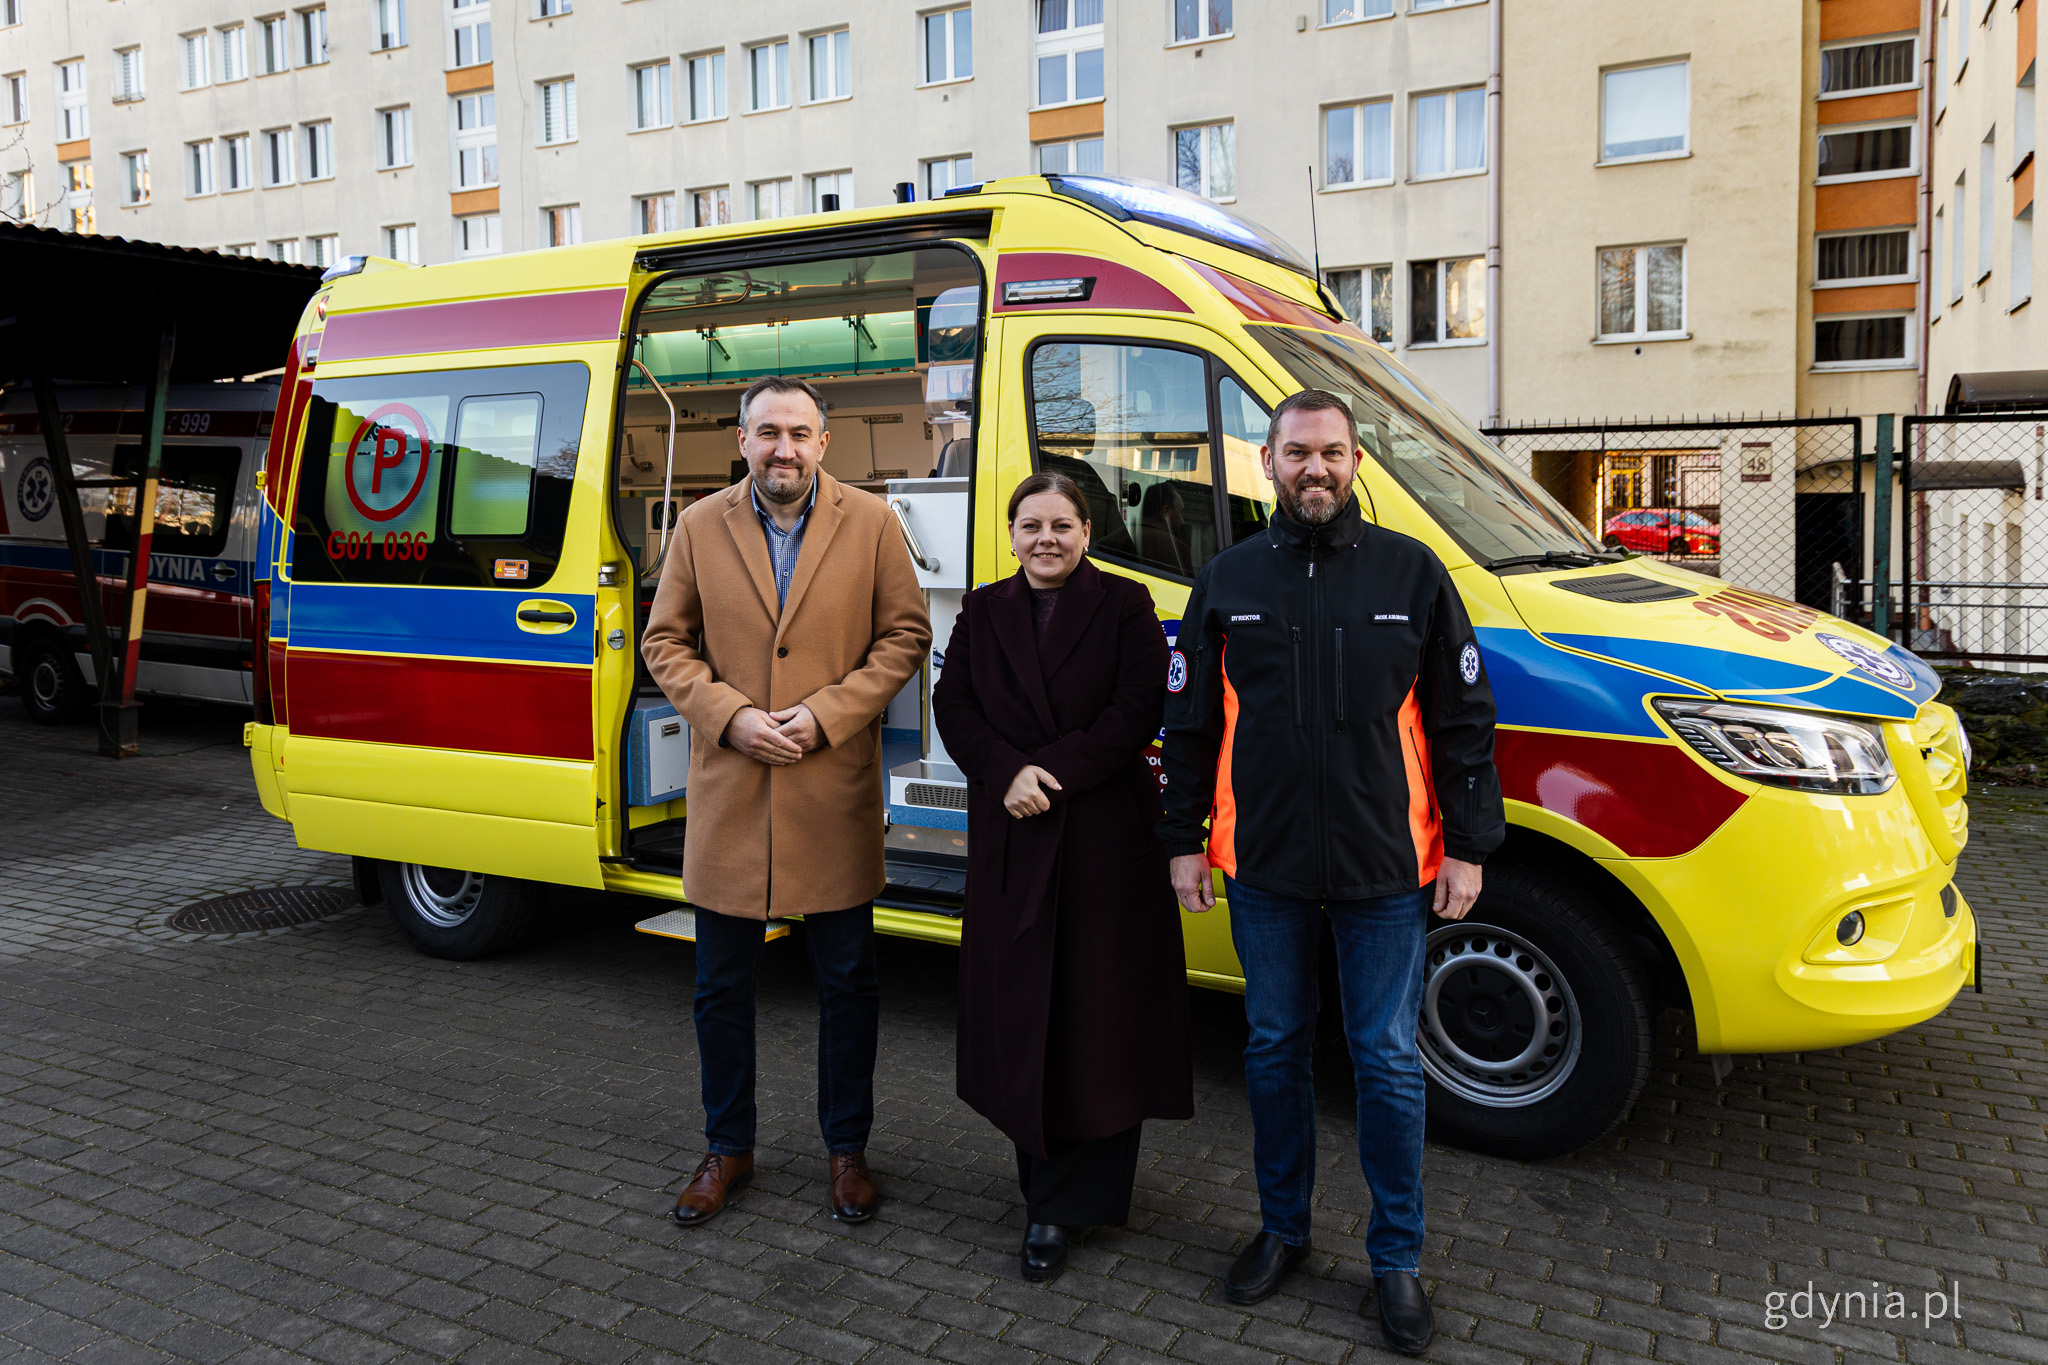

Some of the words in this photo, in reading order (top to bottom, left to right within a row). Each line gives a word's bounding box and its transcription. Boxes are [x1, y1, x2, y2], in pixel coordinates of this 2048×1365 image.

[179, 412, 211, 434] 999
[371, 427, 408, 494] P
[1747, 457, 1767, 472] 48
[327, 531, 373, 560] G01
[383, 531, 428, 561] 036
[1231, 614, 1261, 622] DYREKTOR
